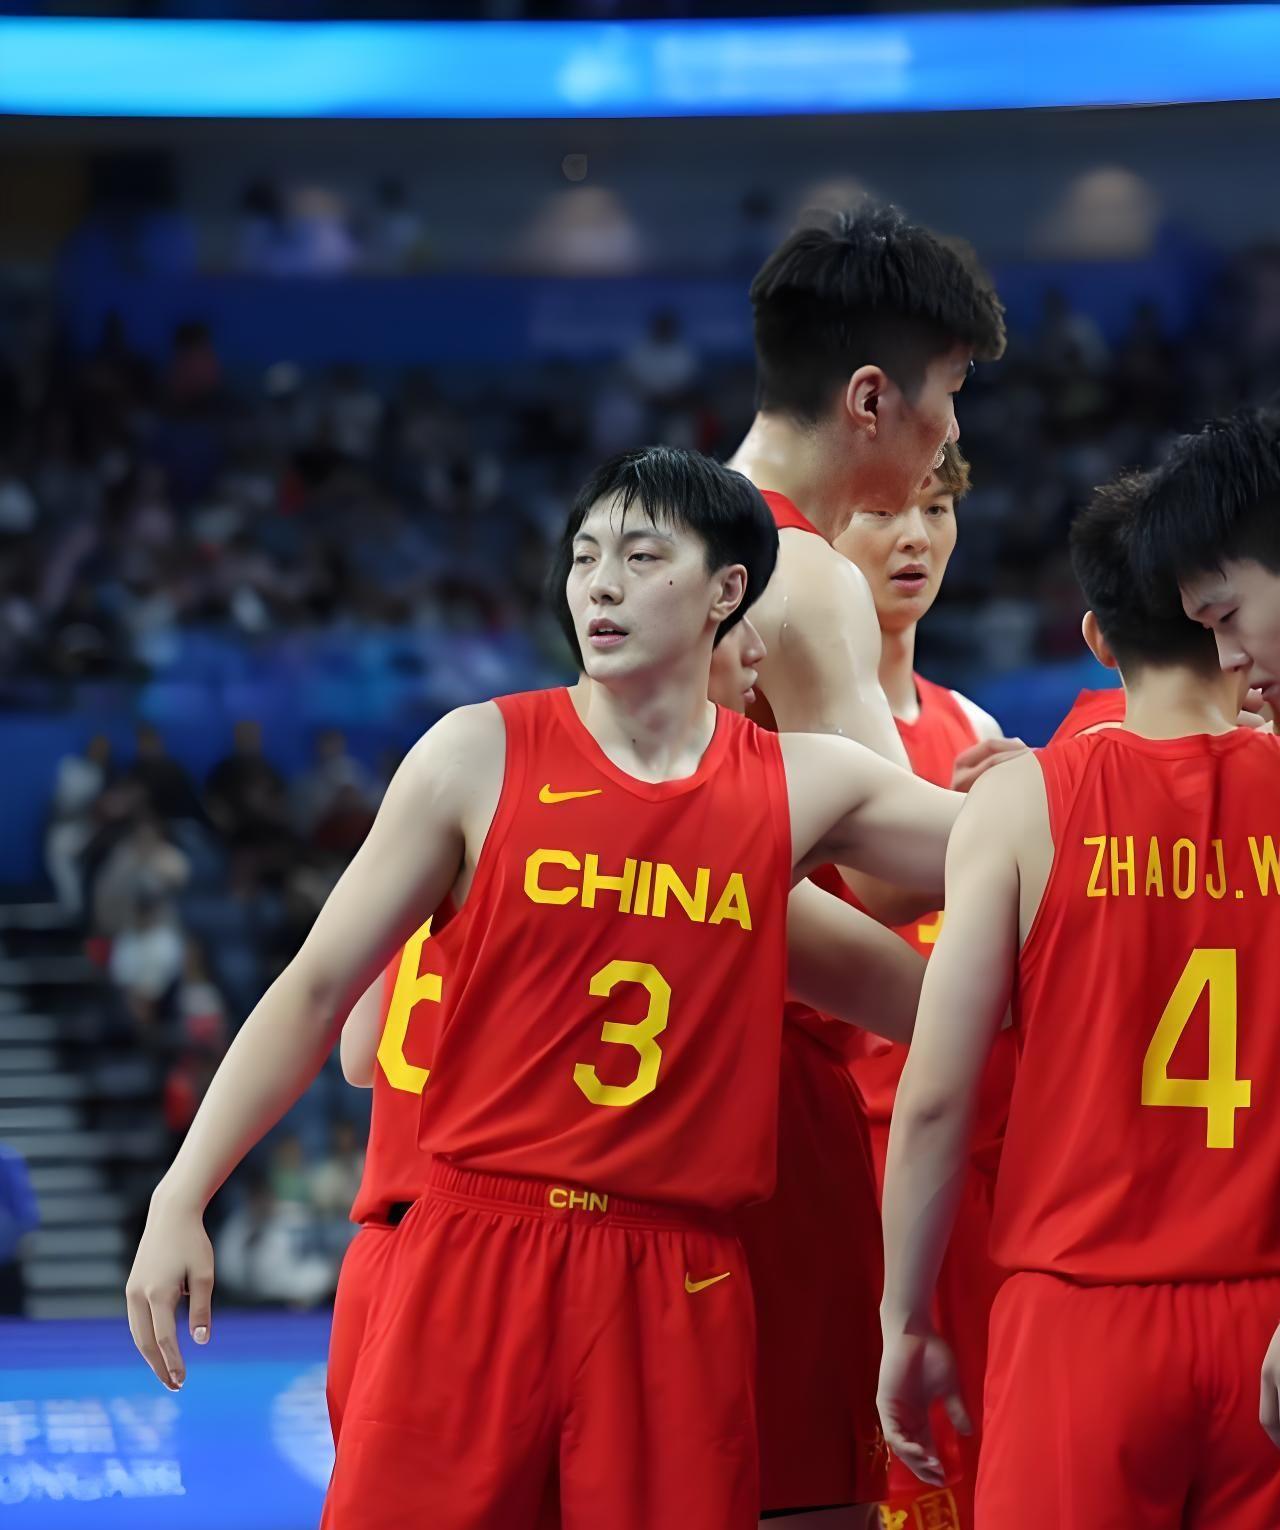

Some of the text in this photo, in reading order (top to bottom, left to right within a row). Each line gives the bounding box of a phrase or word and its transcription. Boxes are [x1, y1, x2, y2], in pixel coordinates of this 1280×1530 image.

[523, 848, 753, 931] CHINA
[573, 959, 672, 1107] 3
[1141, 948, 1252, 1149] 4
[549, 1187, 609, 1213] CHN
